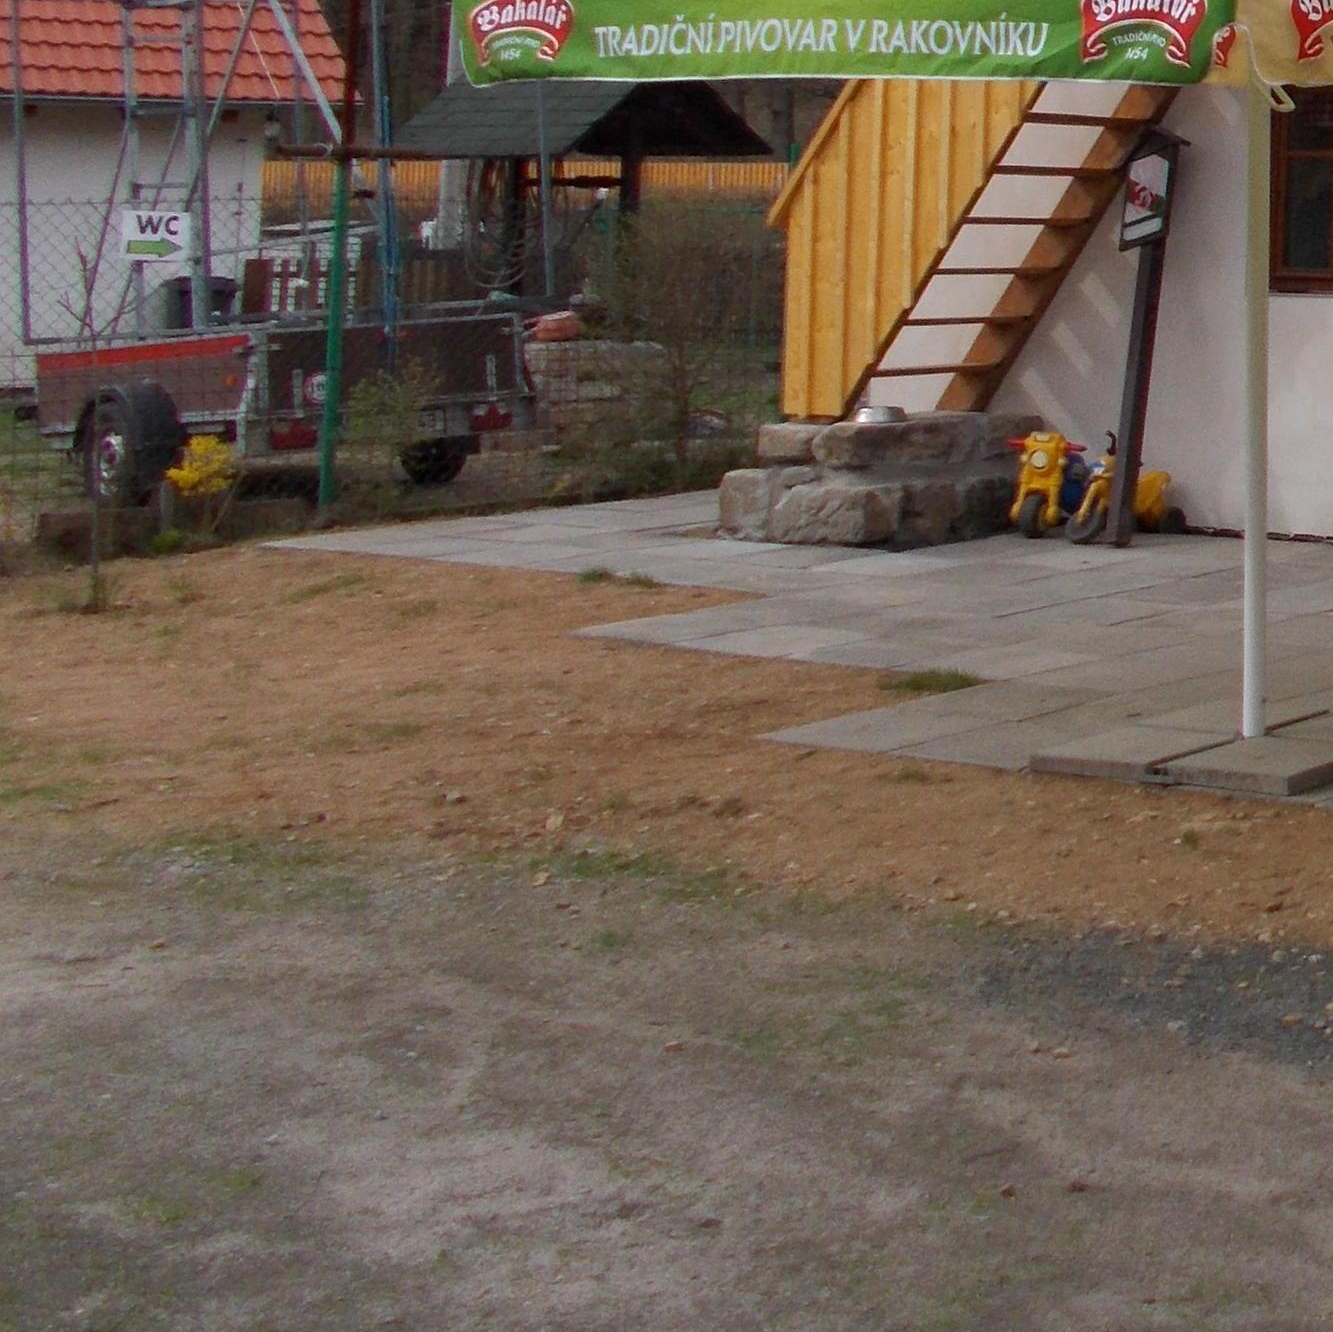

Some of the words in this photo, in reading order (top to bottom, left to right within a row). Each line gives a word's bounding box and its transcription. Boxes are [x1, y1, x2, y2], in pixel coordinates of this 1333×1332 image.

[594, 13, 715, 58] TRADIČNÍ
[717, 18, 837, 53] PIVOVAR
[845, 18, 866, 53] V
[869, 12, 1050, 57] RAKOVNÍKU
[136, 214, 180, 236] WC
